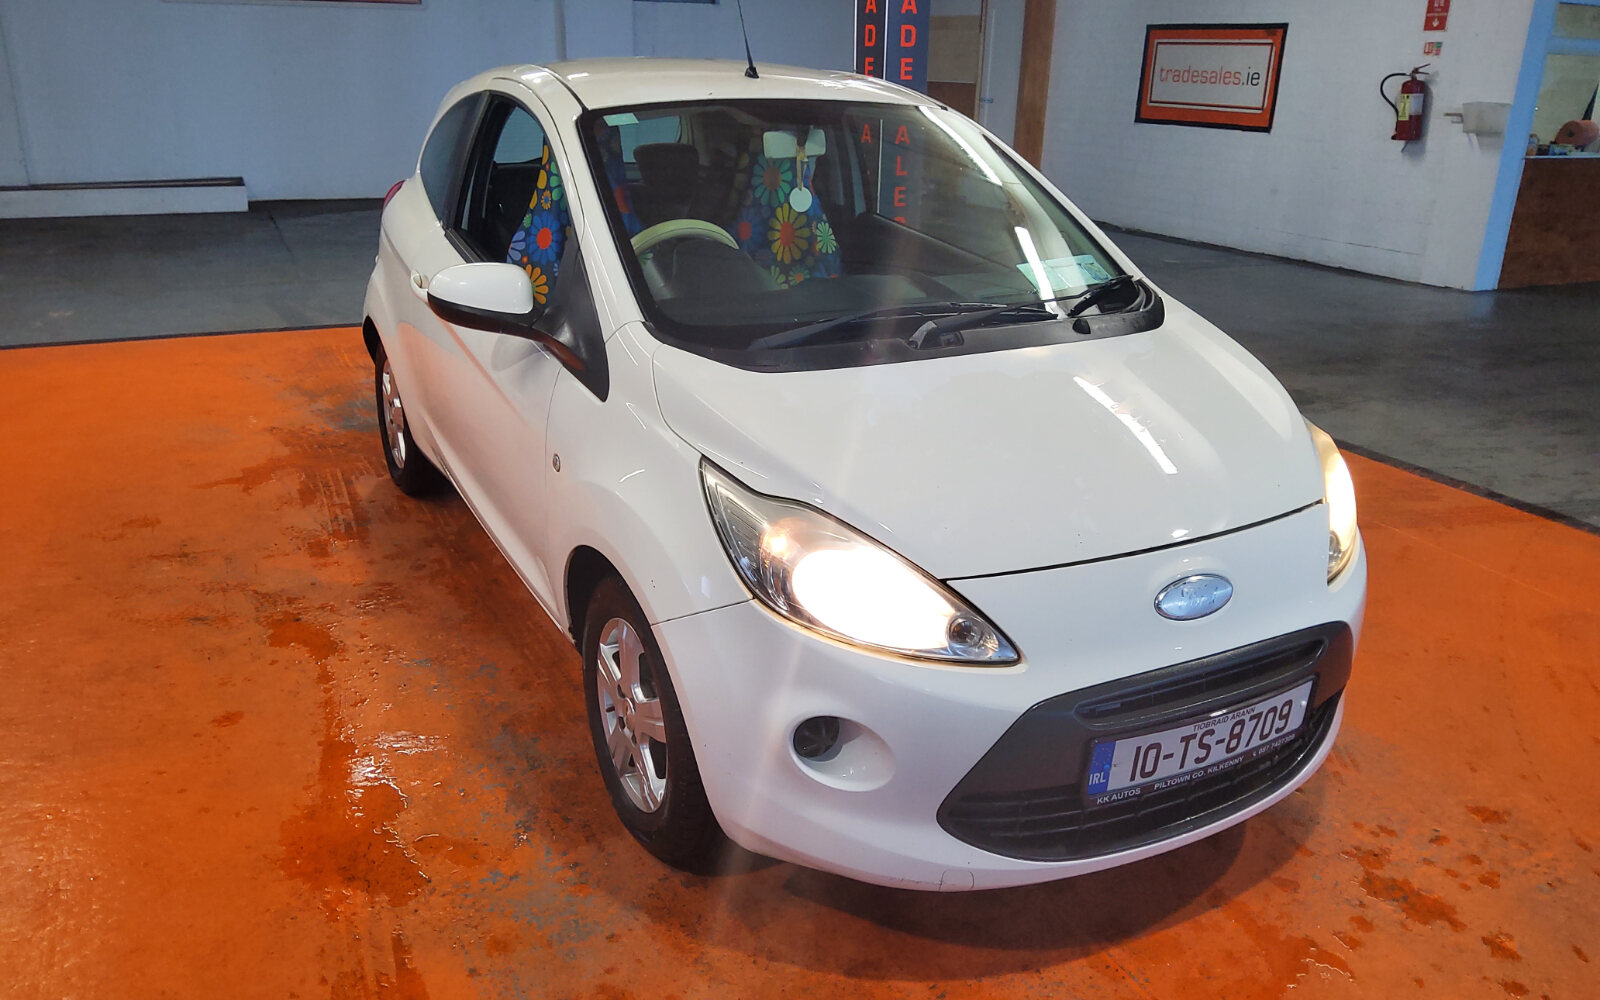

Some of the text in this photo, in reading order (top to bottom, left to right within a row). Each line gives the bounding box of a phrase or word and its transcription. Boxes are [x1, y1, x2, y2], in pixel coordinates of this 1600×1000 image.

[1158, 65, 1261, 87] tradesales.ie
[893, 124, 911, 224] ALE
[1193, 706, 1257, 732] TIOBRAID ARANN
[1129, 698, 1294, 782] 10-TS-8709
[1088, 772, 1106, 786] IRL
[1096, 794, 1110, 805] KK
[1110, 787, 1142, 802] AUTOS
[1153, 773, 1191, 791] PILTOWN
[1191, 770, 1206, 780] CO.
[1207, 755, 1245, 775] KILKENNY
